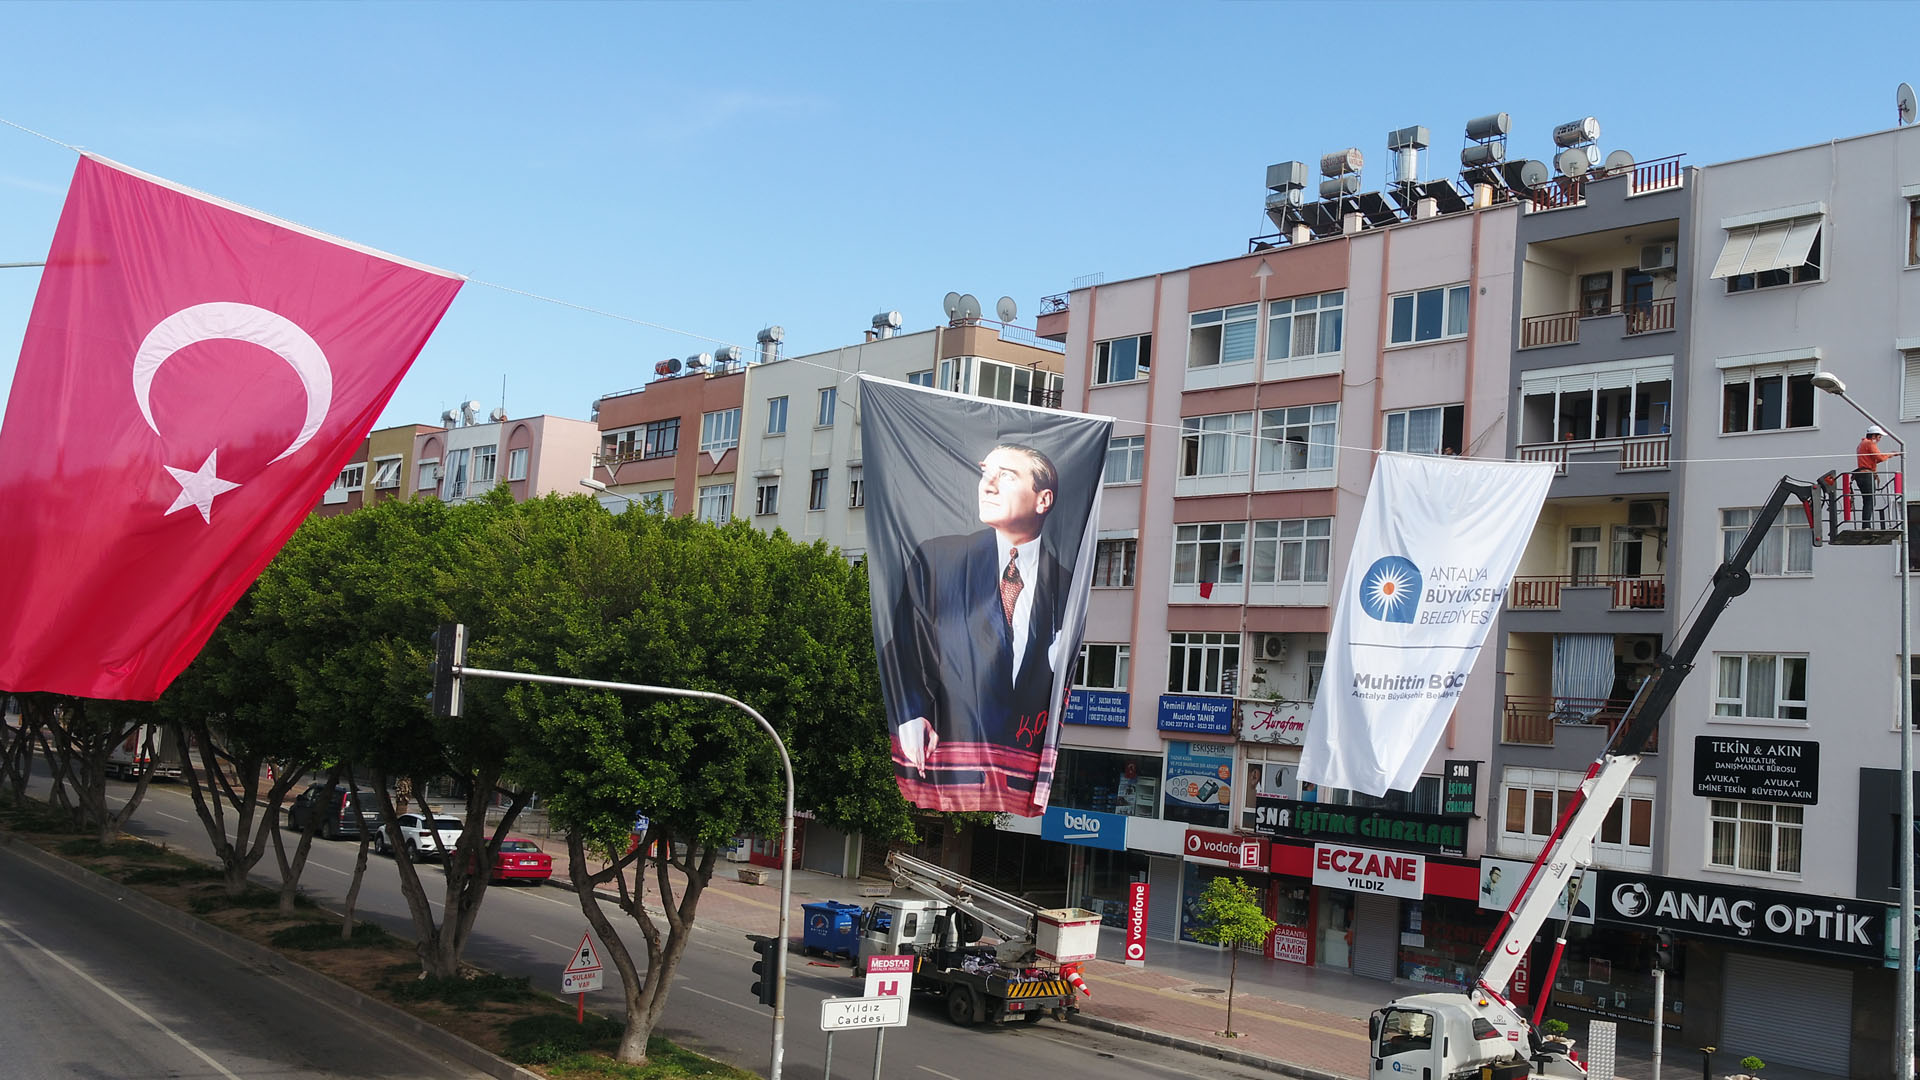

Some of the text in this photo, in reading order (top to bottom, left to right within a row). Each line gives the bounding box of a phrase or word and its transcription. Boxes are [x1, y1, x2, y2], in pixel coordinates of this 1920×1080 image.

[1429, 566, 1488, 582] ANTALYA
[1420, 607, 1493, 625] BELEDİYESİ
[1353, 672, 1425, 690] Muhittin
[1352, 690, 1386, 701] Antalya
[1387, 690, 1424, 701] Büyükşehir
[1162, 700, 1228, 714] Yeminli Mali Müşavir
[1172, 712, 1215, 722] Mustafa TANIR
[1251, 710, 1304, 734] Auraform
[1712, 740, 1801, 758] TEKİN & AKIN
[1734, 756, 1777, 764] AVUKATLIK
[1715, 762, 1796, 774] DANIŞMANLIK BÜROSU
[1704, 774, 1740, 784] AVUKAT
[1764, 778, 1800, 788] AVUKAT
[1698, 783, 1746, 794] EMİNE TEKİN
[1752, 786, 1812, 799] RÜVEYDA AKIN
[1063, 811, 1101, 833] beko
[1295, 805, 1358, 835] İŞİTME
[1316, 847, 1417, 882] ECZANE
[1347, 877, 1385, 892] YILDIZ
[1133, 885, 1145, 940] vodafone
[1655, 889, 1756, 937] ANAÇ
[1764, 904, 1874, 946] OPTİK
[872, 958, 910, 968] MEDSTAR
[844, 1003, 880, 1013] Yıldız
[837, 1014, 885, 1025] Caddesi
